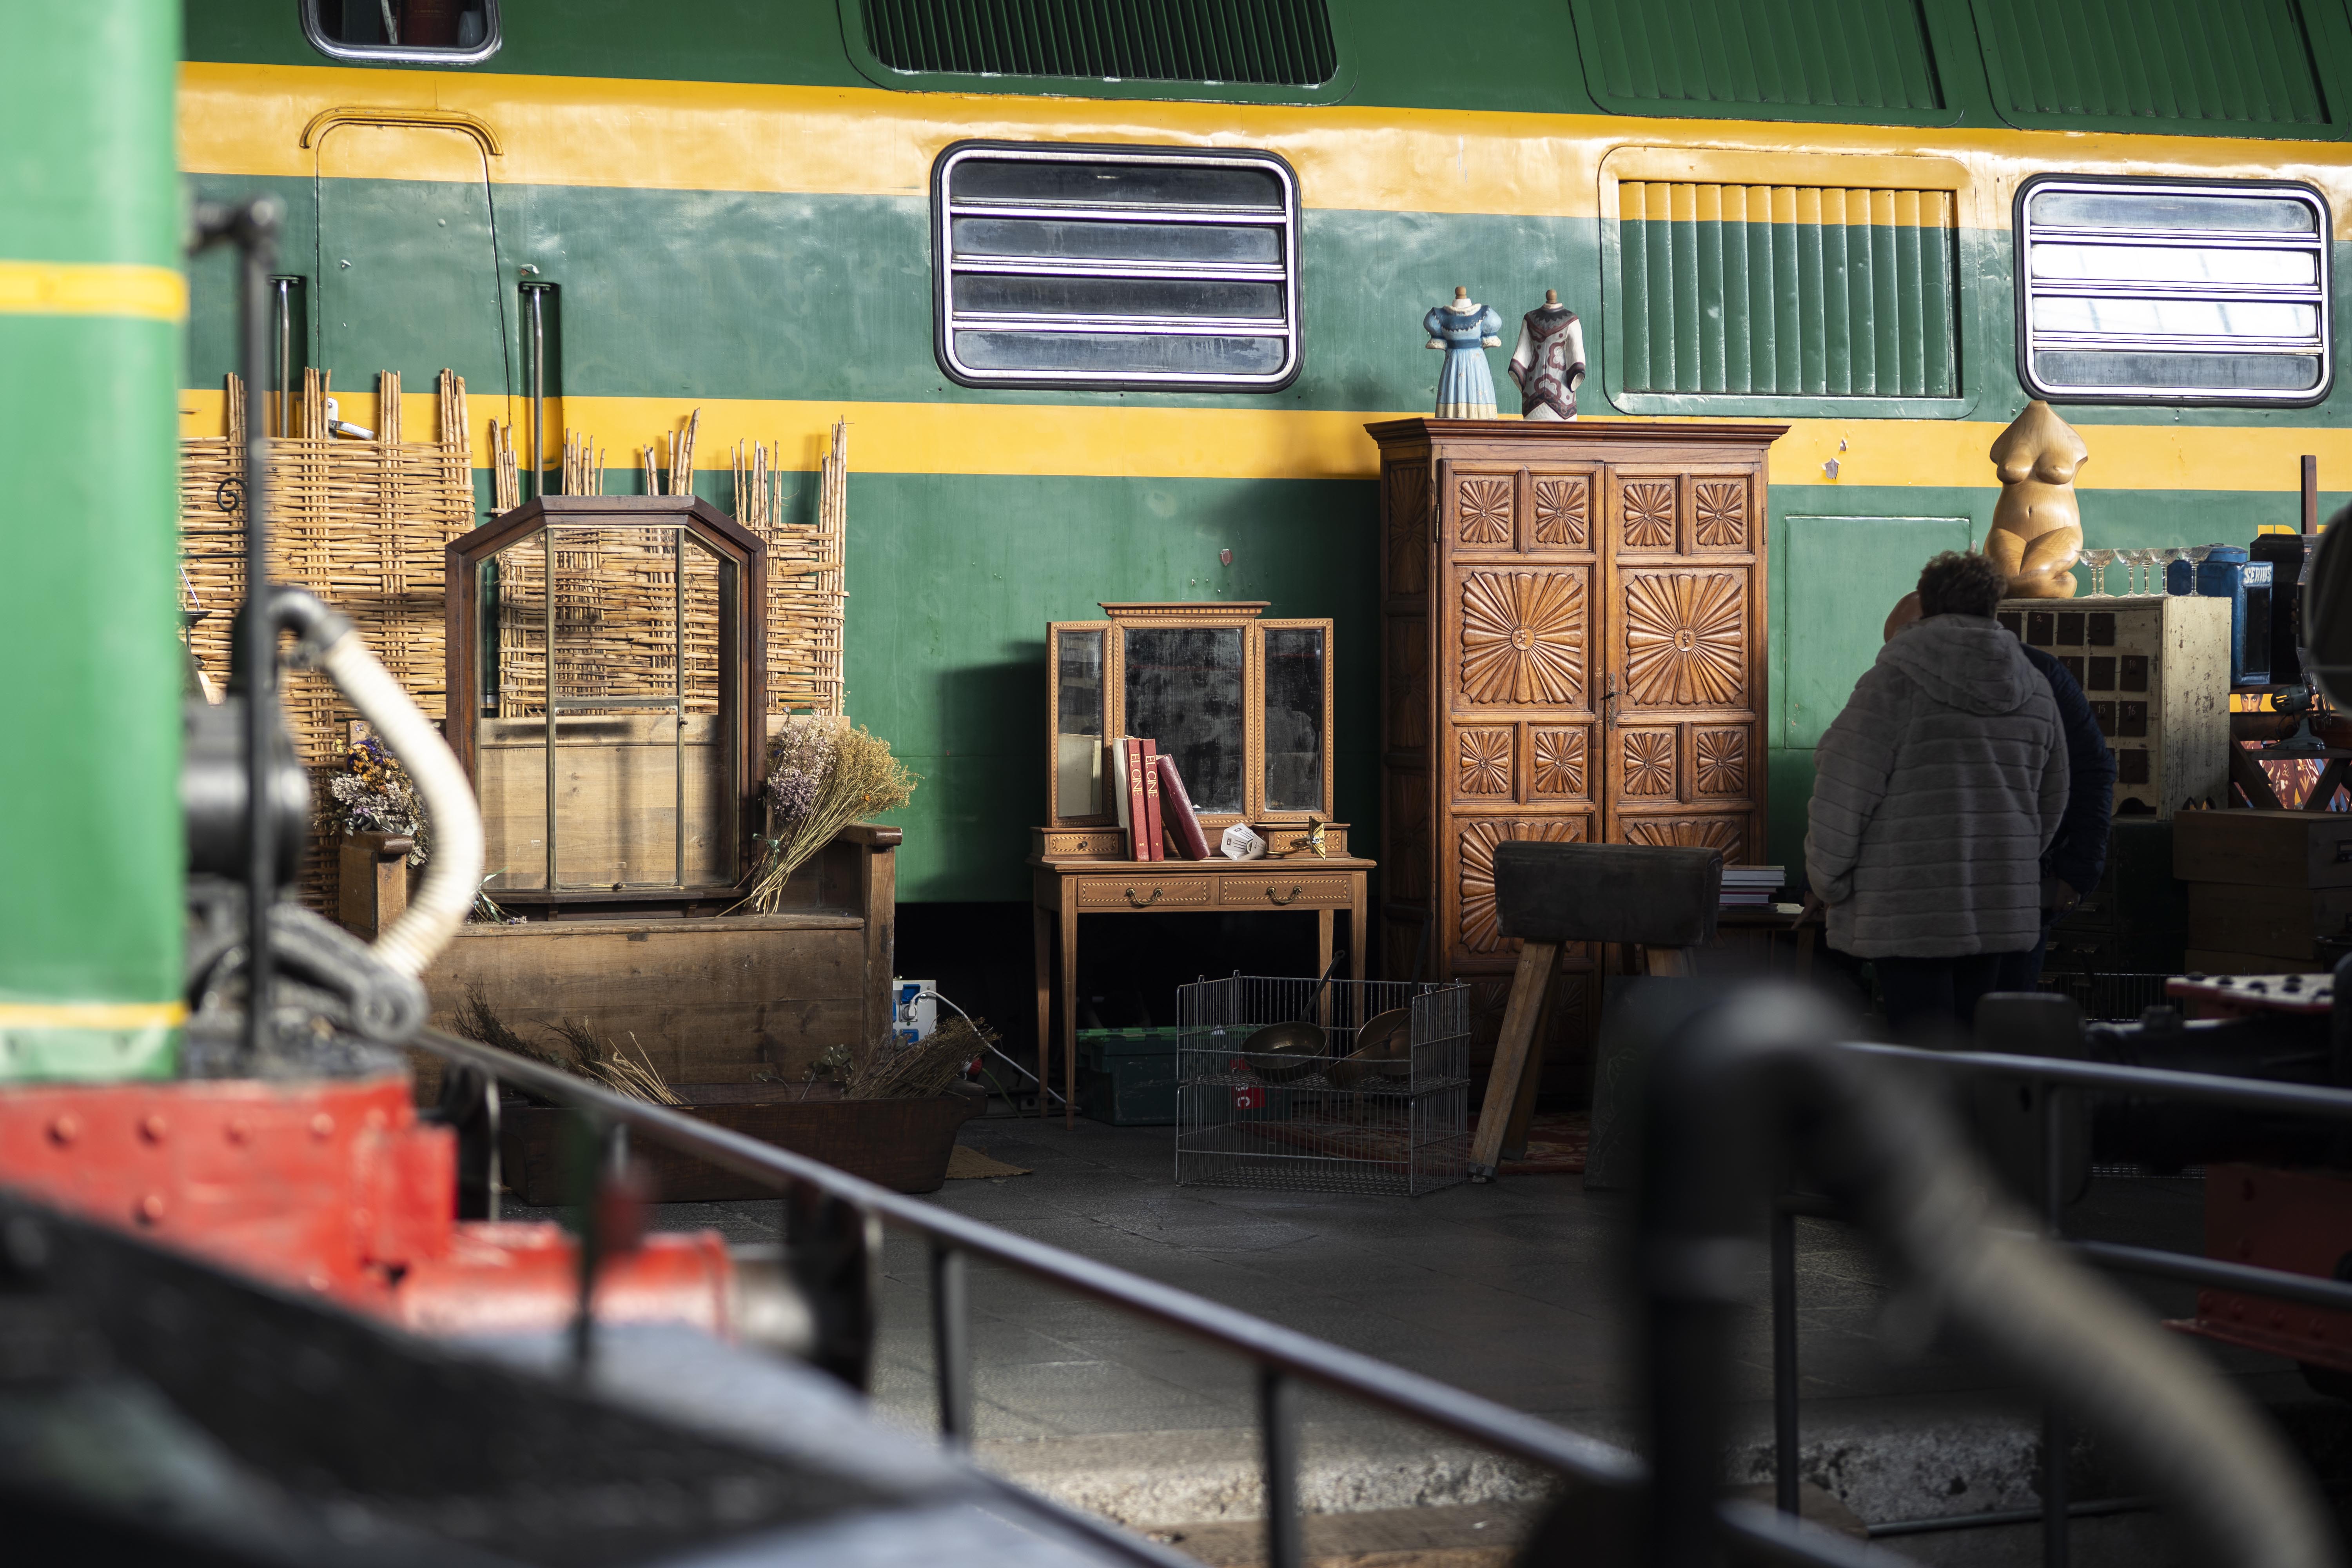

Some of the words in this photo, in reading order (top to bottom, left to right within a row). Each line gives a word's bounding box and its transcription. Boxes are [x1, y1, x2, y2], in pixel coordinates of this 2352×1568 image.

[2243, 566, 2272, 584] SERIUS
[2129, 659, 2136, 668] 10
[2098, 704, 2106, 714] 15
[2127, 704, 2136, 716] 16
[1131, 753, 1140, 767] EL
[1145, 755, 1155, 768] EL
[1132, 768, 1143, 796] CINE
[1147, 770, 1158, 798] CINE
